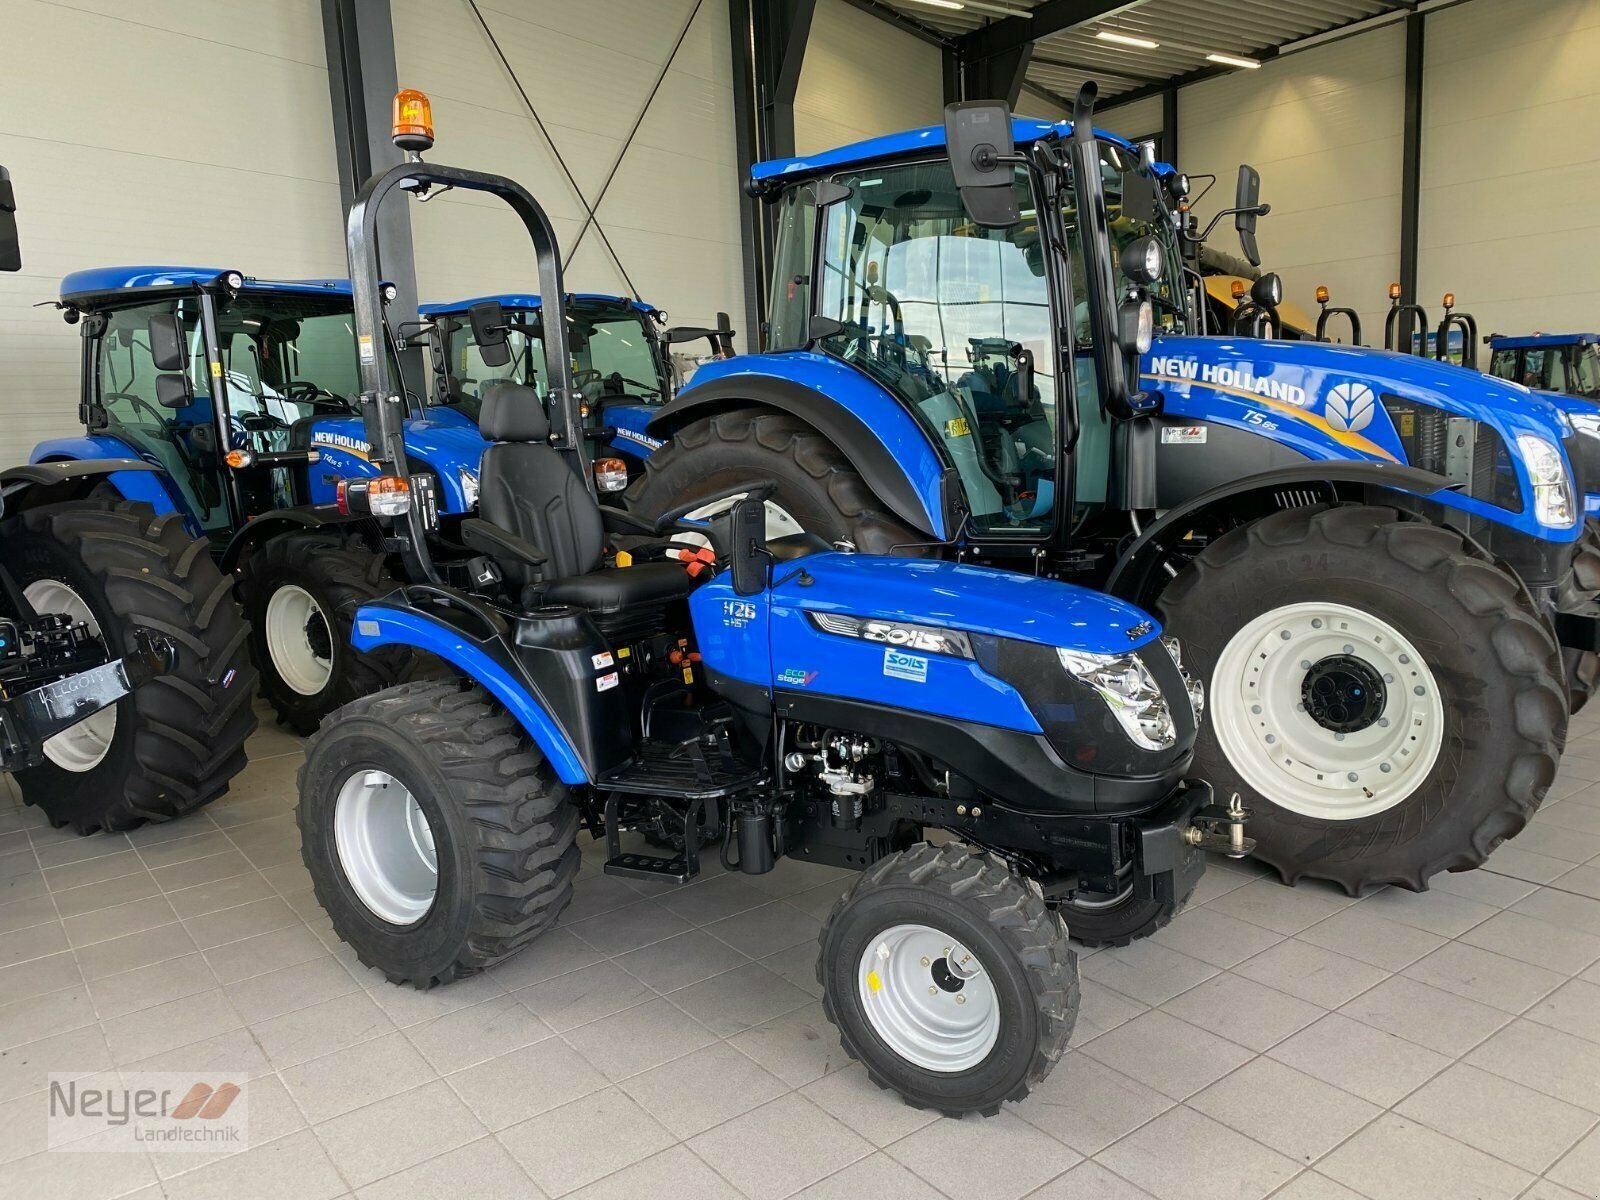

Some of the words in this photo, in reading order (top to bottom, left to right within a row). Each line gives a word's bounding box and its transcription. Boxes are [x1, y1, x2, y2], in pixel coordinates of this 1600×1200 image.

[1151, 357, 1199, 379] NEW
[1202, 364, 1305, 406] HOLLAND
[617, 427, 631, 437] NEW
[314, 432, 334, 443] NEW
[335, 434, 369, 453] HOLLAN
[785, 669, 806, 678] ECO
